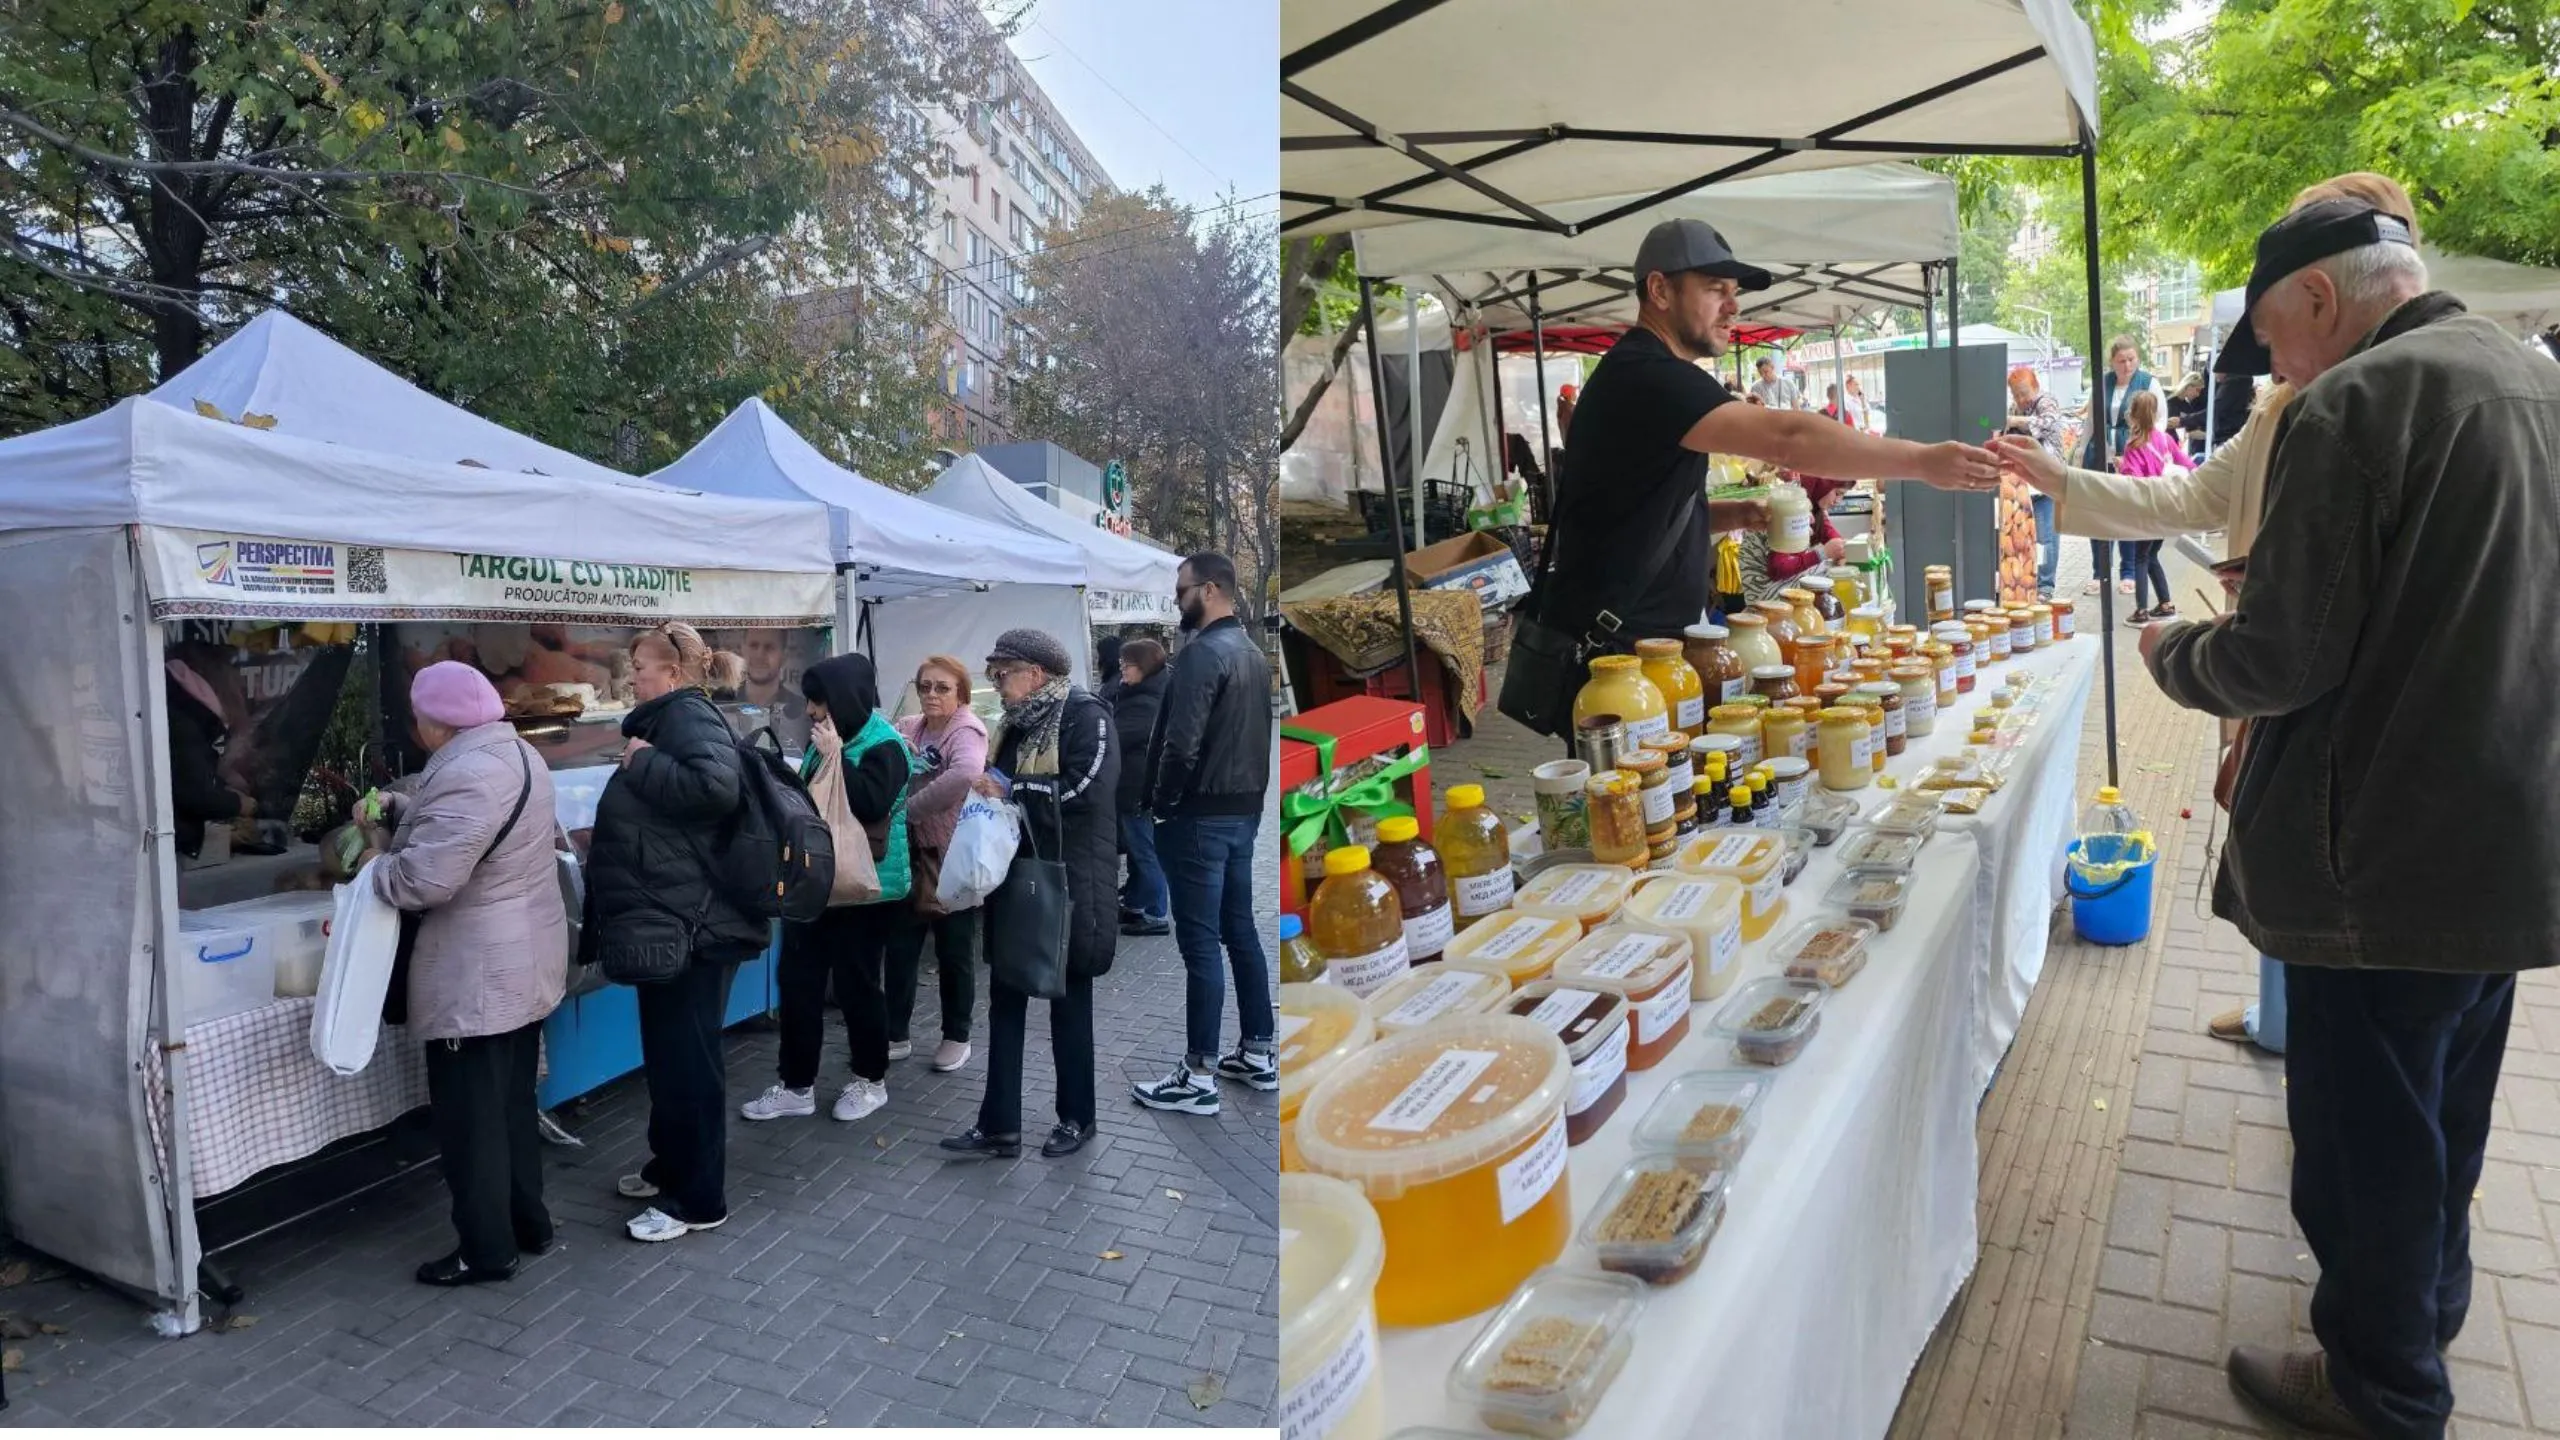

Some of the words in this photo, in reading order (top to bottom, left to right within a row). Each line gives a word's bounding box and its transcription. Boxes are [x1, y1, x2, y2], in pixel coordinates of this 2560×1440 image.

[236, 541, 334, 567] PERSPECTIVA
[571, 561, 602, 587] CU
[504, 586, 598, 604] PRODUCĂTORI
[1340, 961, 1368, 975] MIERE
[1370, 957, 1381, 970] DE
[1342, 975, 1365, 987] МЕД
[1310, 1377, 1325, 1399] DE
